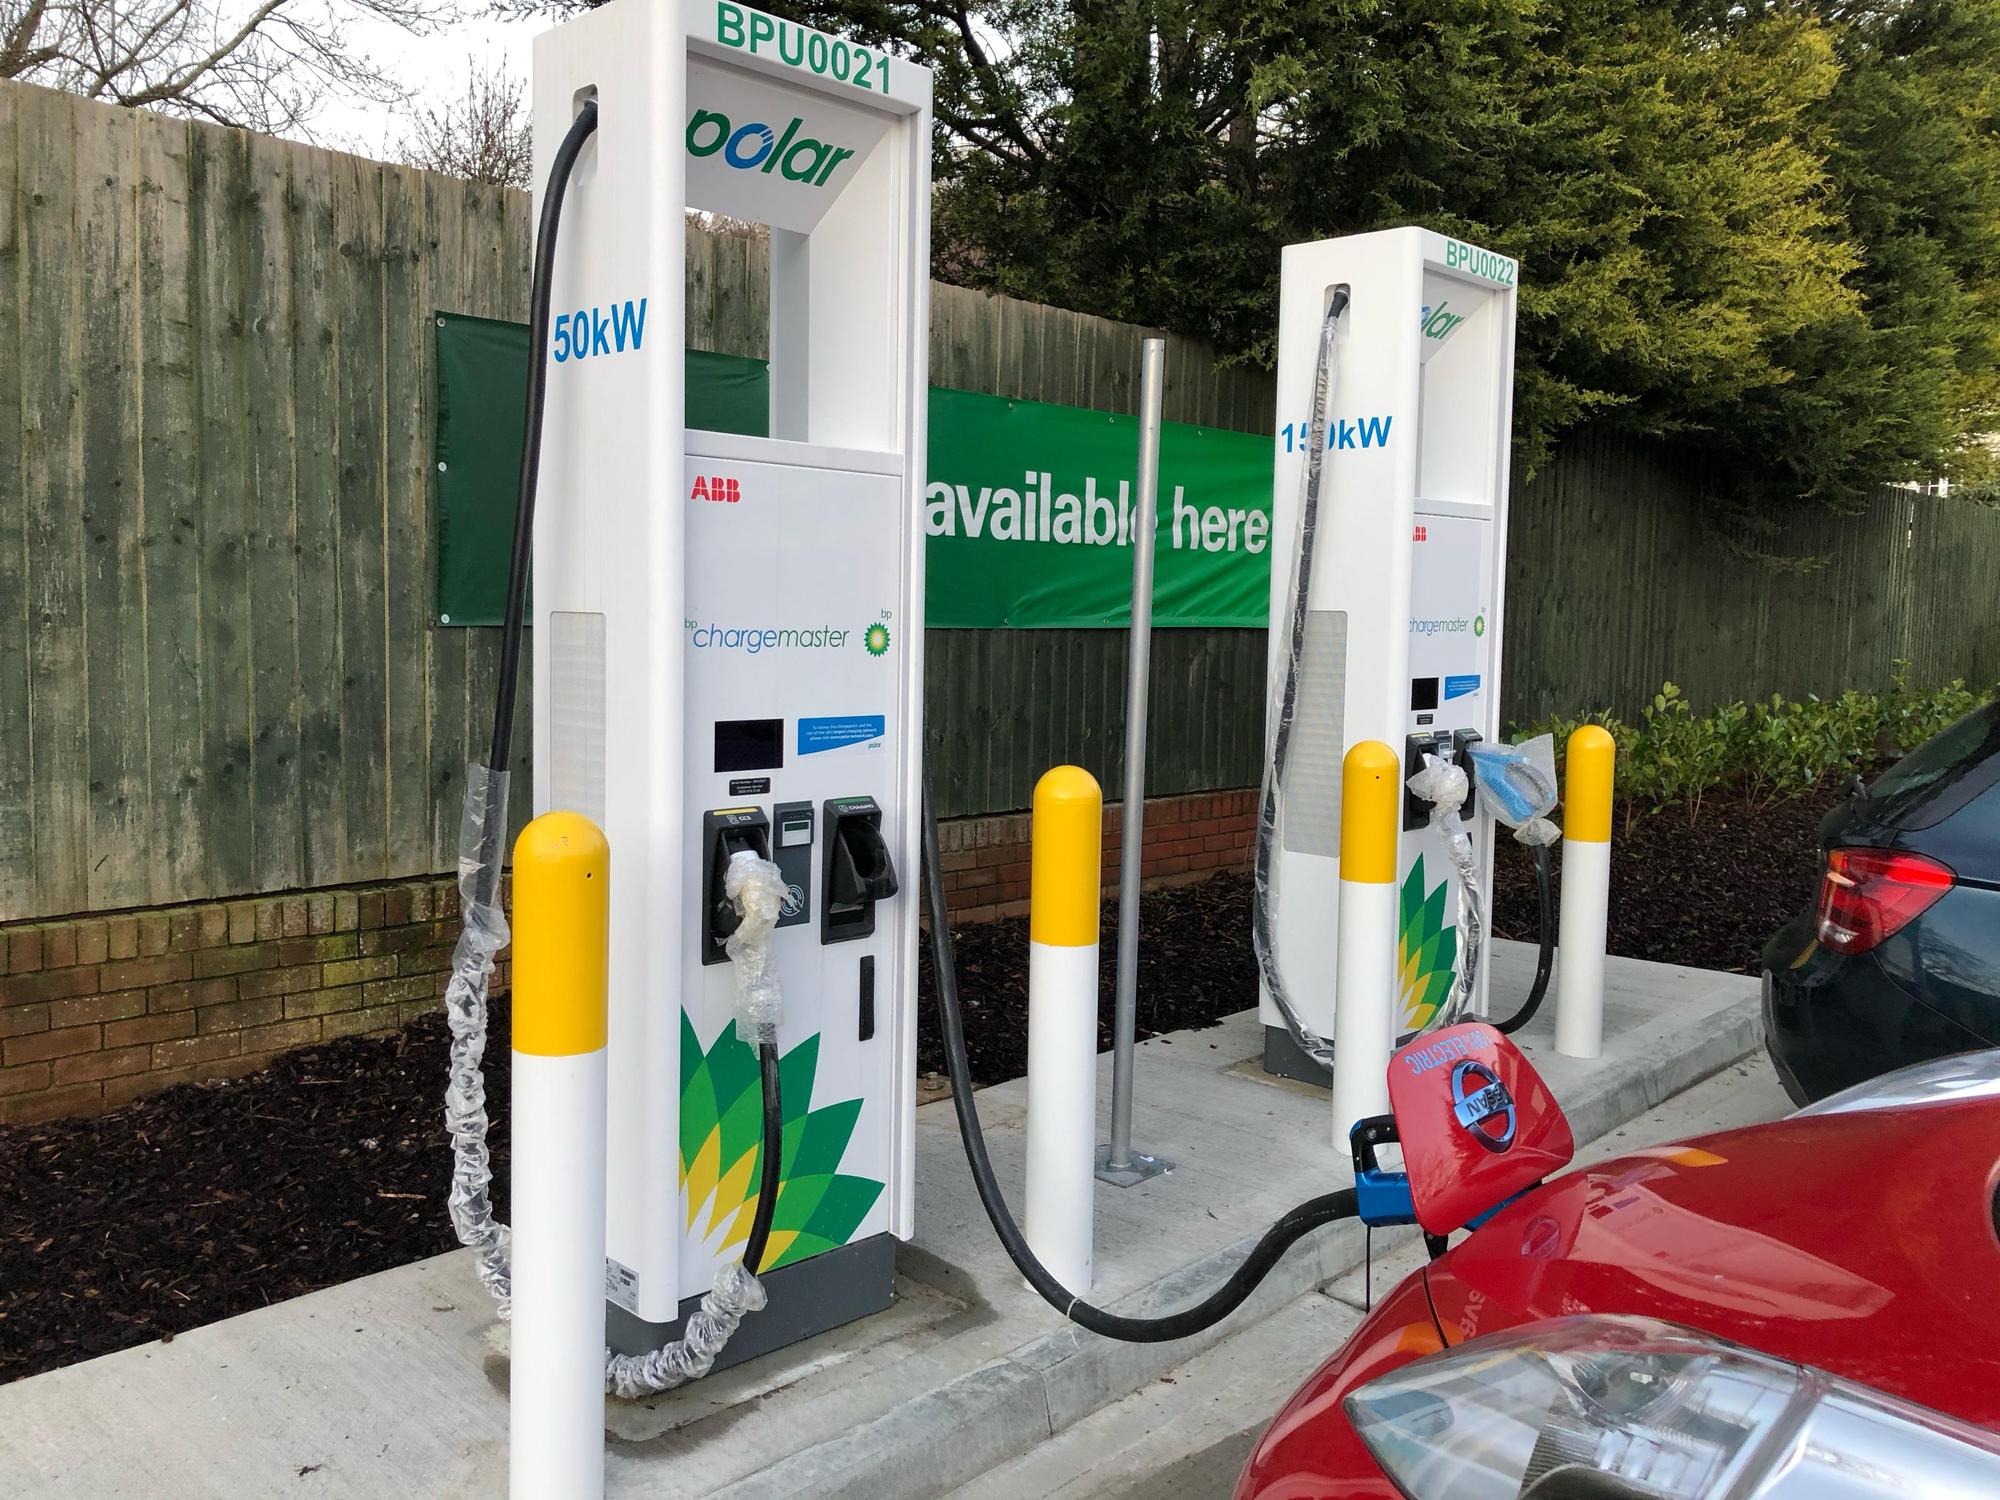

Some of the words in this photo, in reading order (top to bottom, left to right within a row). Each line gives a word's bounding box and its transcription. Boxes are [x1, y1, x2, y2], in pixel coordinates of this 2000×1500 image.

[717, 0, 891, 95] BPU0021
[686, 108, 855, 188] polar
[1446, 240, 1514, 285] BPU0022
[553, 298, 648, 363] 50kW
[691, 476, 741, 503] ABB
[1173, 486, 1269, 554] here
[1413, 526, 1427, 541] BB
[881, 608, 892, 620] bp
[684, 618, 698, 630] bp
[693, 624, 850, 654] chargemaster
[1403, 1036, 1469, 1076] ELECTRIC
